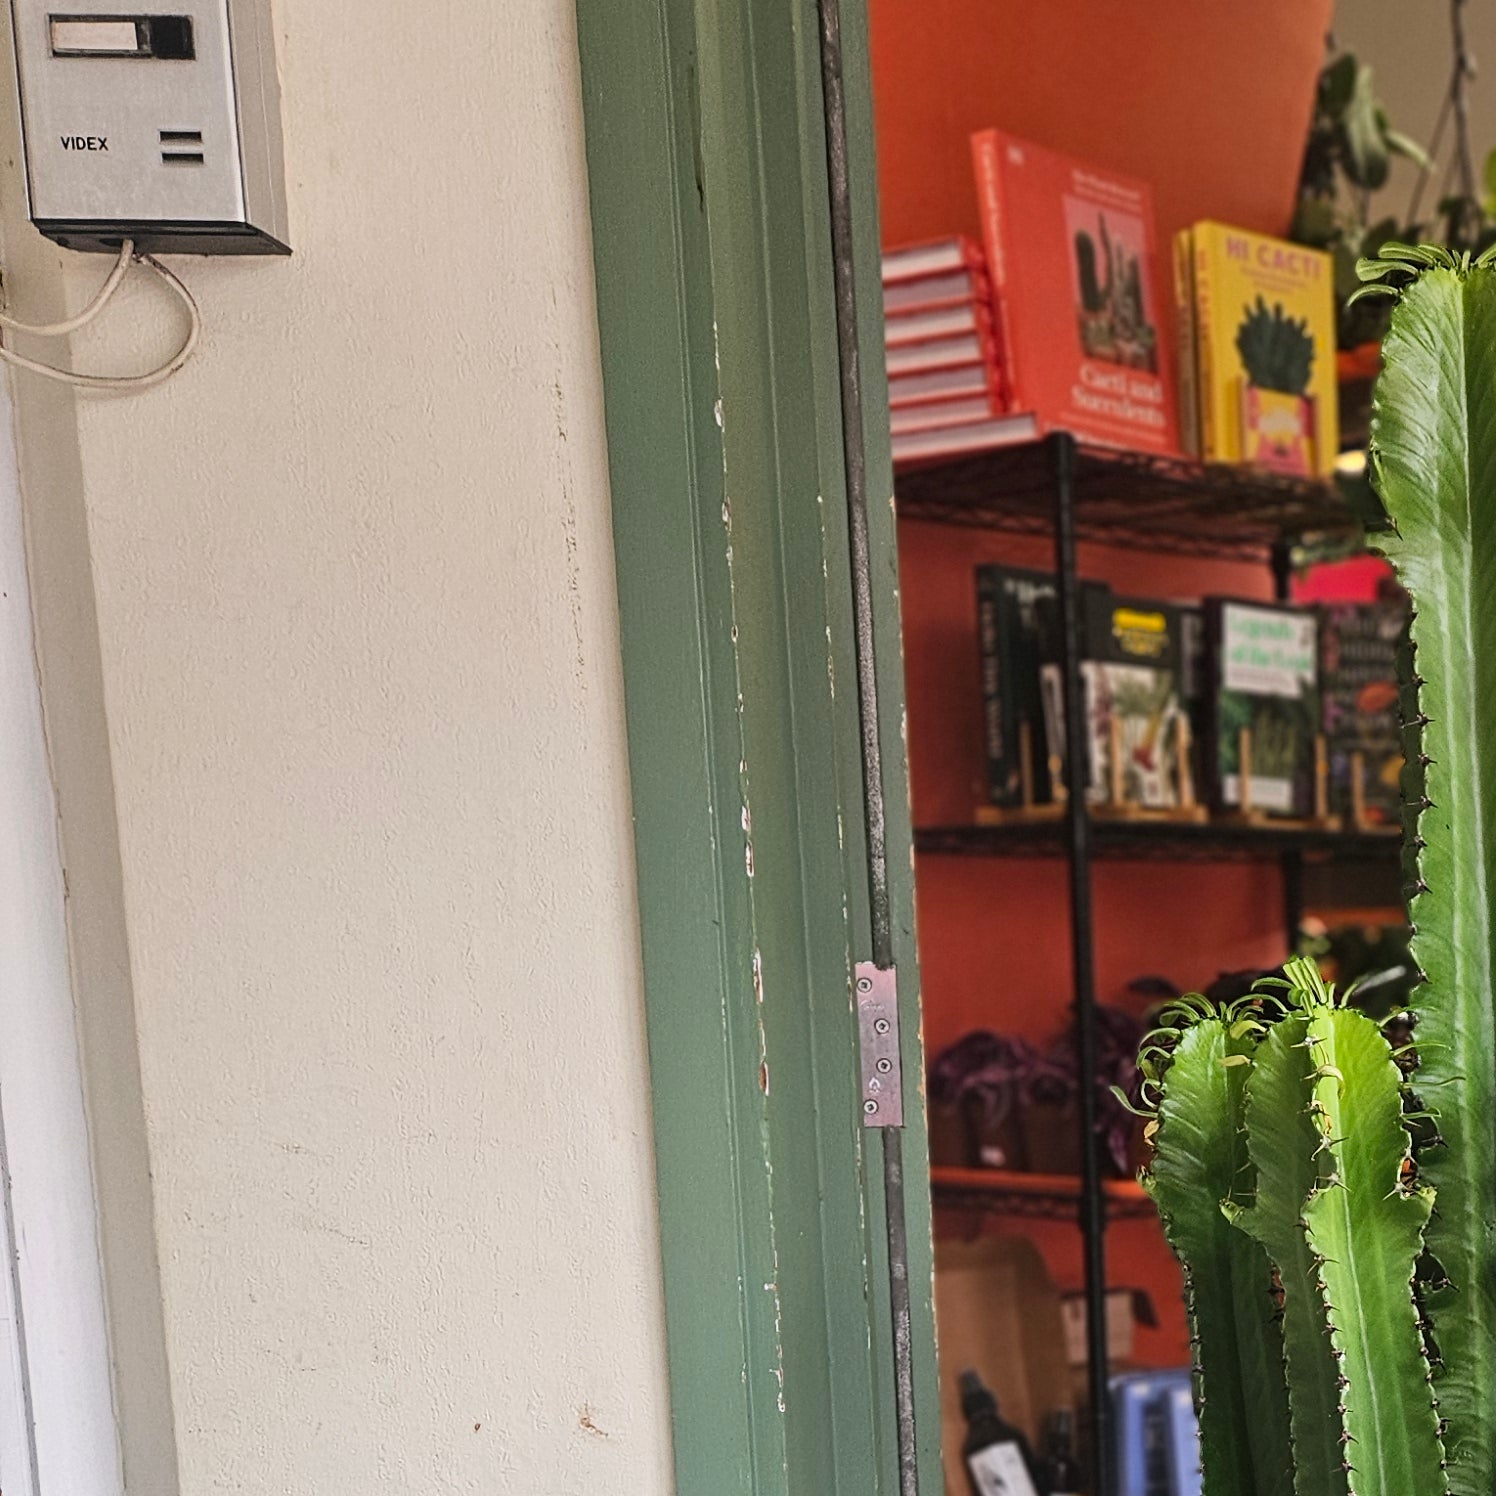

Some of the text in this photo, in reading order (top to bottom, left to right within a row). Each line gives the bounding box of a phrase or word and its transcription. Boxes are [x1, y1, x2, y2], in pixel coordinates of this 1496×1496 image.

[60, 136, 109, 151] VIDEX
[1226, 235, 1322, 279] HI CACTI
